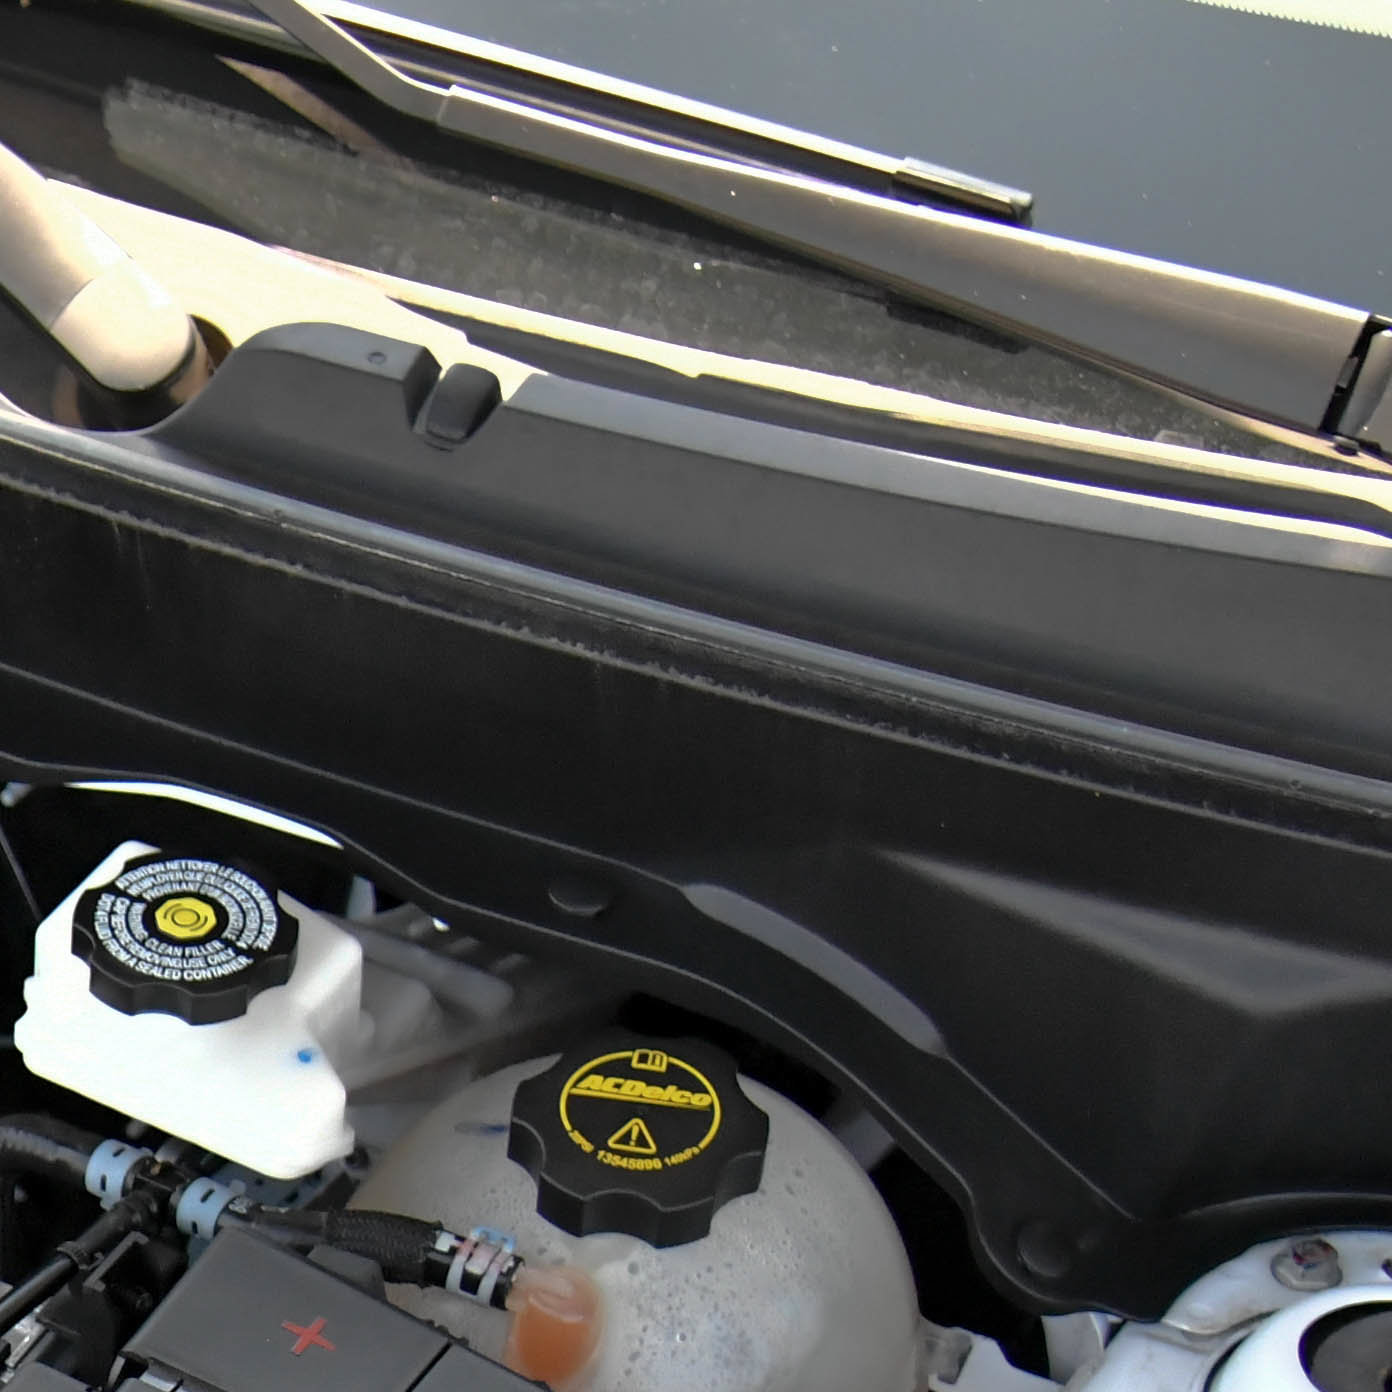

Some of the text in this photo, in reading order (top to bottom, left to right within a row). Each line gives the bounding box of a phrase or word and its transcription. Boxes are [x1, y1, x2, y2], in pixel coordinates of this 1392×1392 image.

[184, 939, 226, 958] FILLER
[134, 959, 182, 981] SEALED
[182, 955, 207, 969] USE
[576, 1073, 714, 1107] ACDelco
